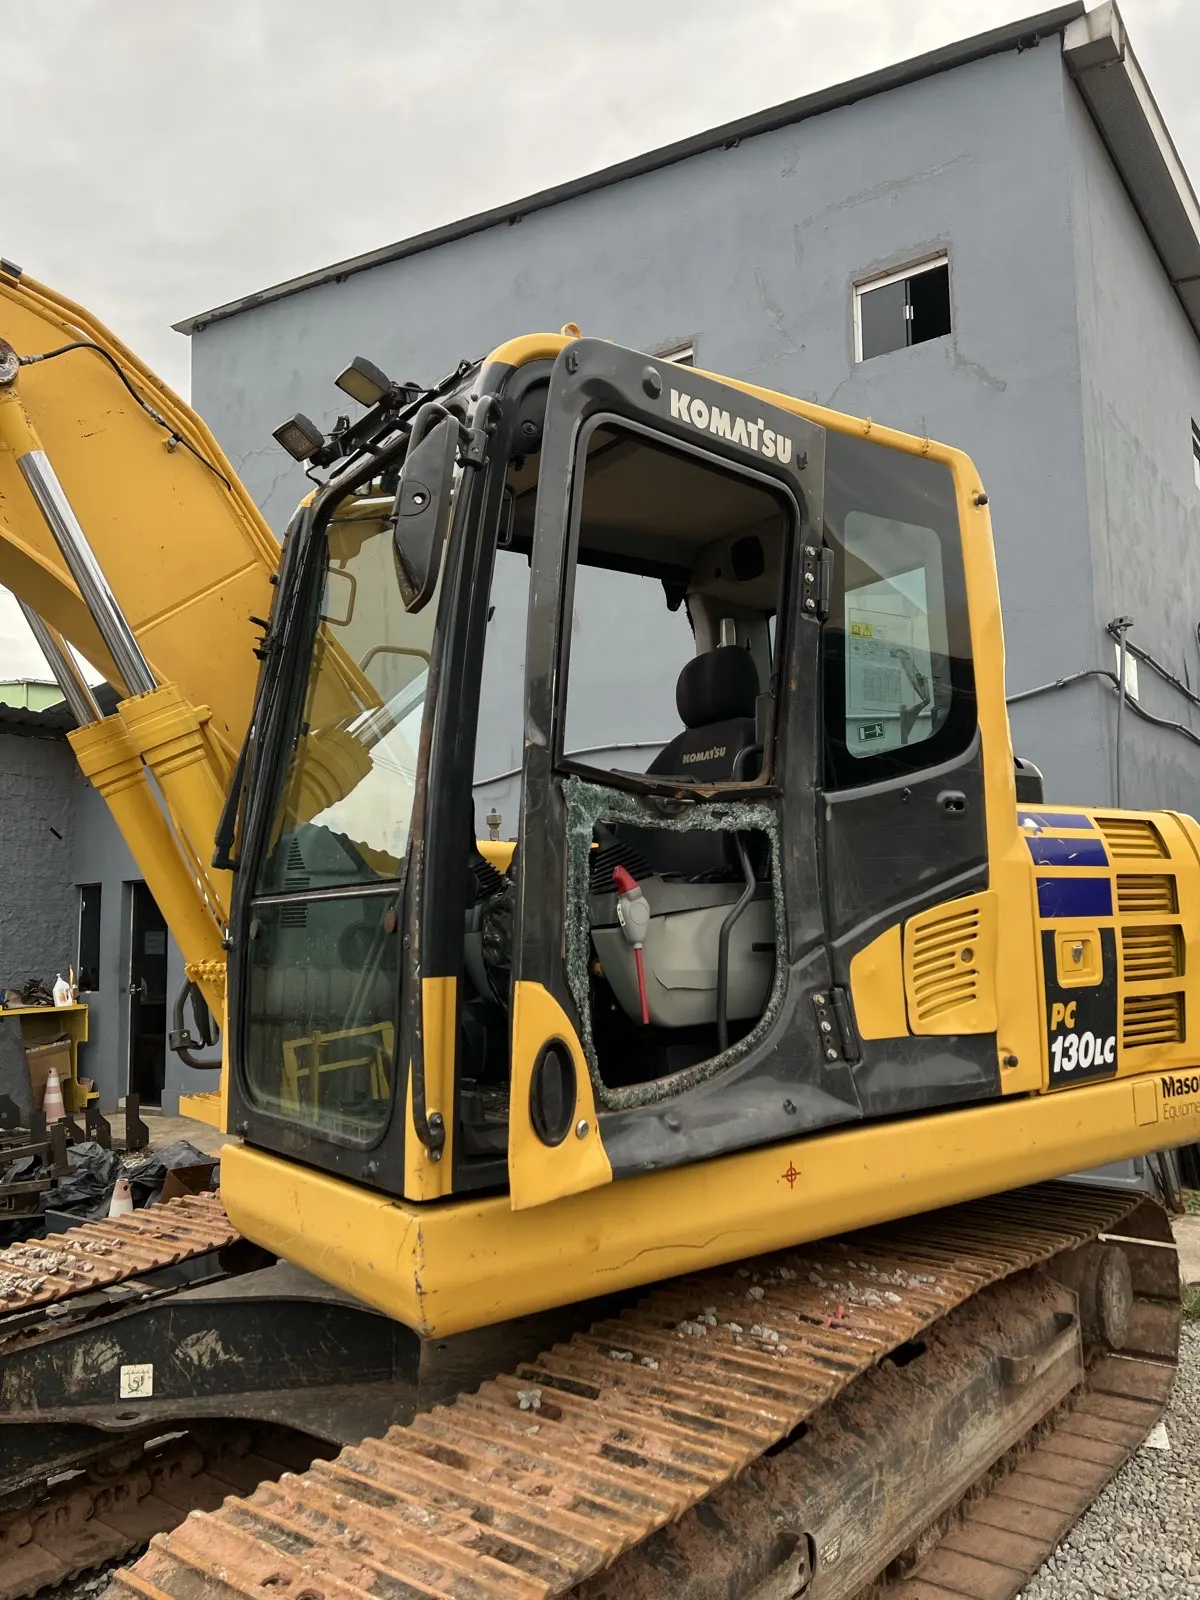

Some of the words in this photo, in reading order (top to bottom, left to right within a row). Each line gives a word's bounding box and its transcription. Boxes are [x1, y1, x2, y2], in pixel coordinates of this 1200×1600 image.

[670, 388, 792, 464] KOMATSU
[682, 746, 726, 764] KOMATSU
[1051, 1001, 1077, 1031] PC
[1051, 1031, 1116, 1073] 130LC
[1160, 1076, 1200, 1098] Maso
